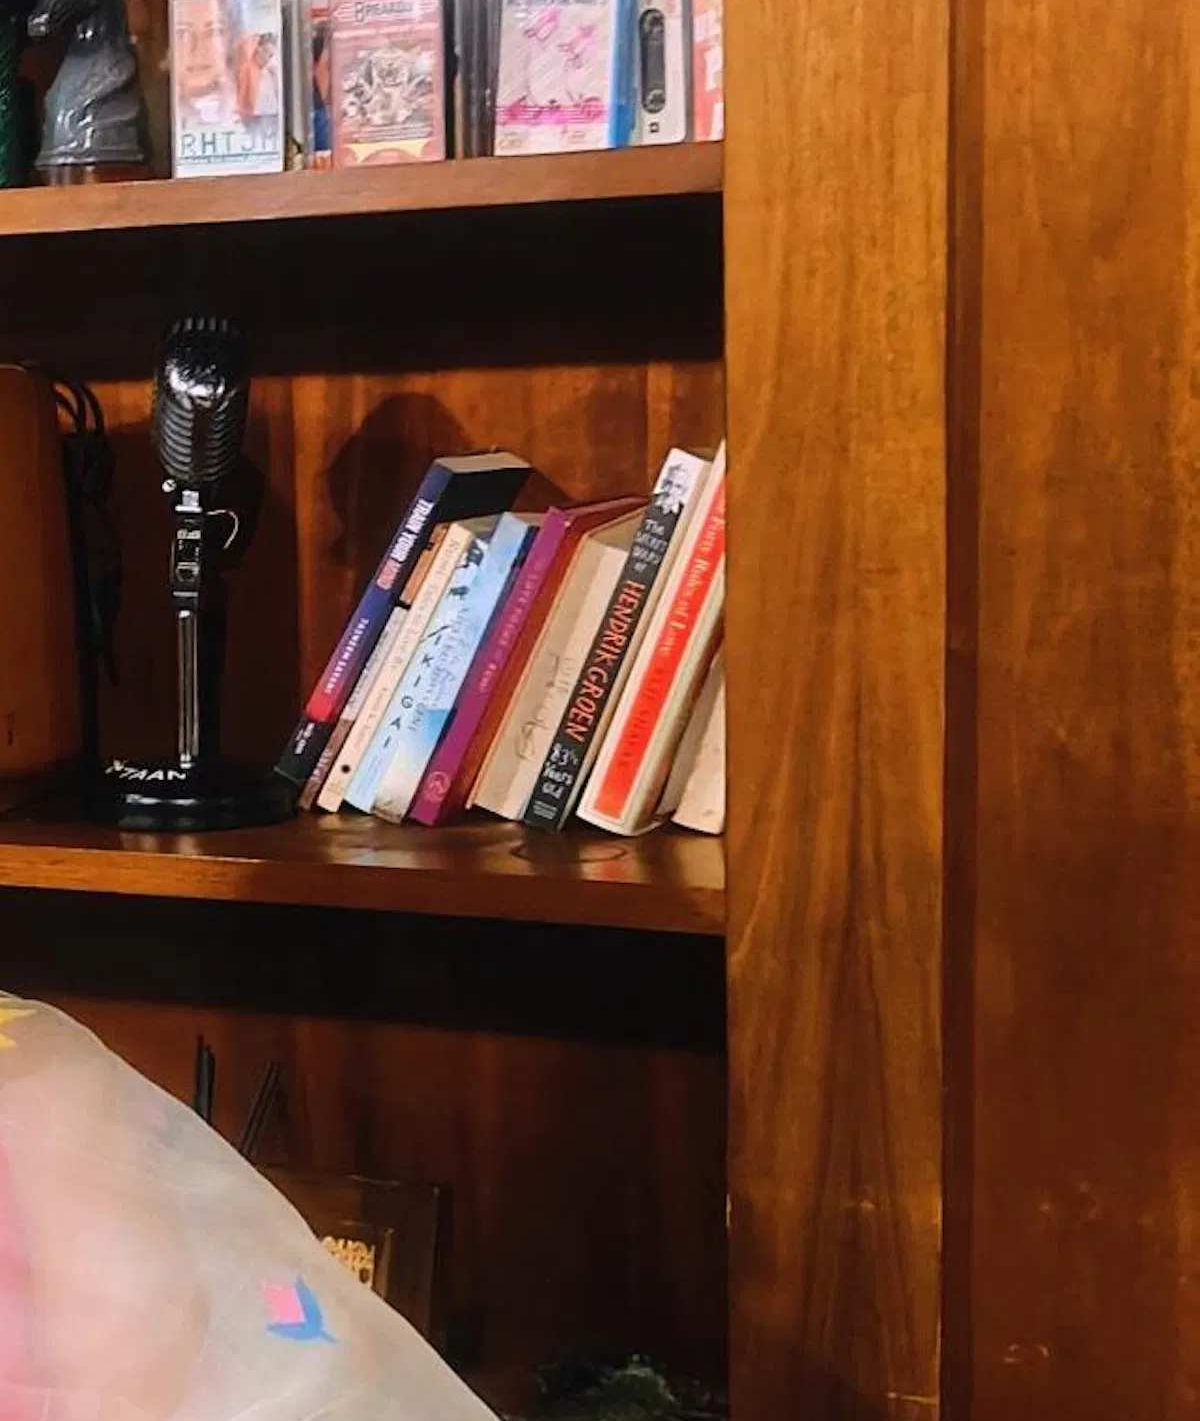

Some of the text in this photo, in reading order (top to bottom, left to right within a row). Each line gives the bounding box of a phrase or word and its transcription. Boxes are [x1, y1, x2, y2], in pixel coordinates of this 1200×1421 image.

[404, 496, 434, 536] TRAIN
[389, 530, 417, 564] YOUR
[593, 580, 648, 668] HENDRIK
[562, 667, 611, 742] GROEN
